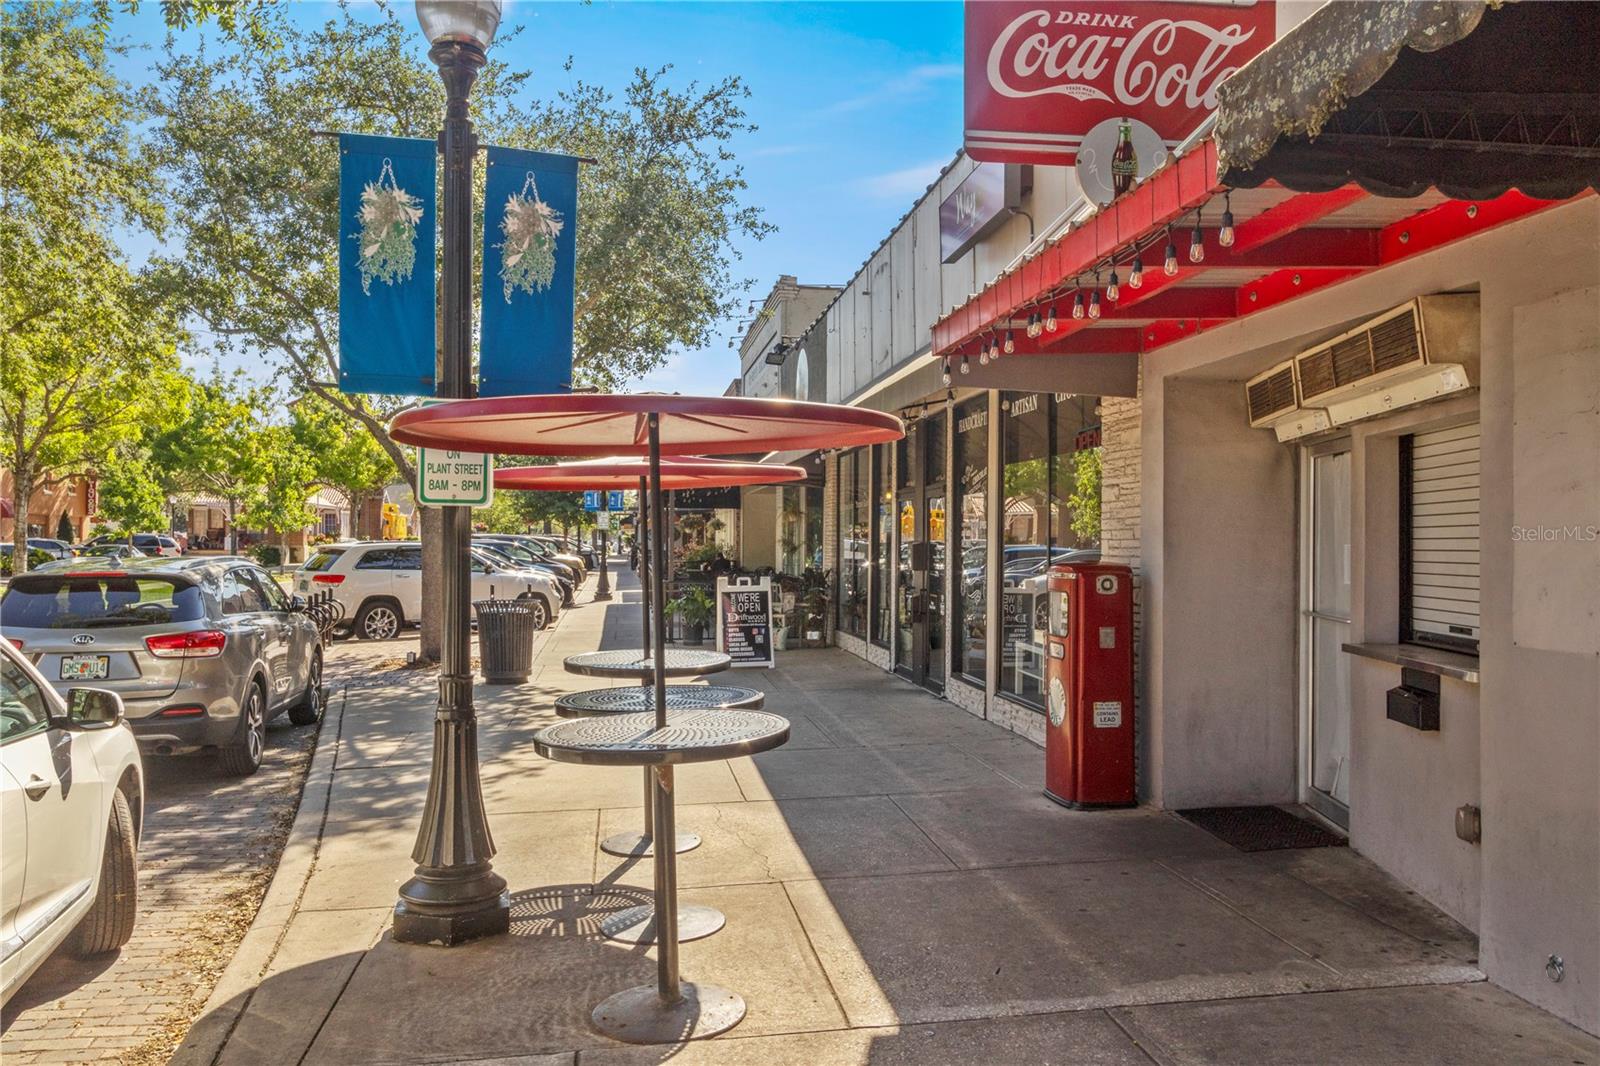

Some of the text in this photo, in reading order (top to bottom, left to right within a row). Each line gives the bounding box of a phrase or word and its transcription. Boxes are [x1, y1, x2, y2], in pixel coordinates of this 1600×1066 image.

[1055, 11, 1139, 29] DRINK
[1010, 394, 1038, 417] ARTISAN
[446, 451, 461, 459] ON
[427, 463, 483, 475] PLANT STREET
[428, 479, 449, 491] 8AM
[461, 480, 481, 491] 8PM
[737, 602, 761, 613] OPEN
[727, 612, 767, 622] Driftwood
[75, 636, 92, 644] KIA
